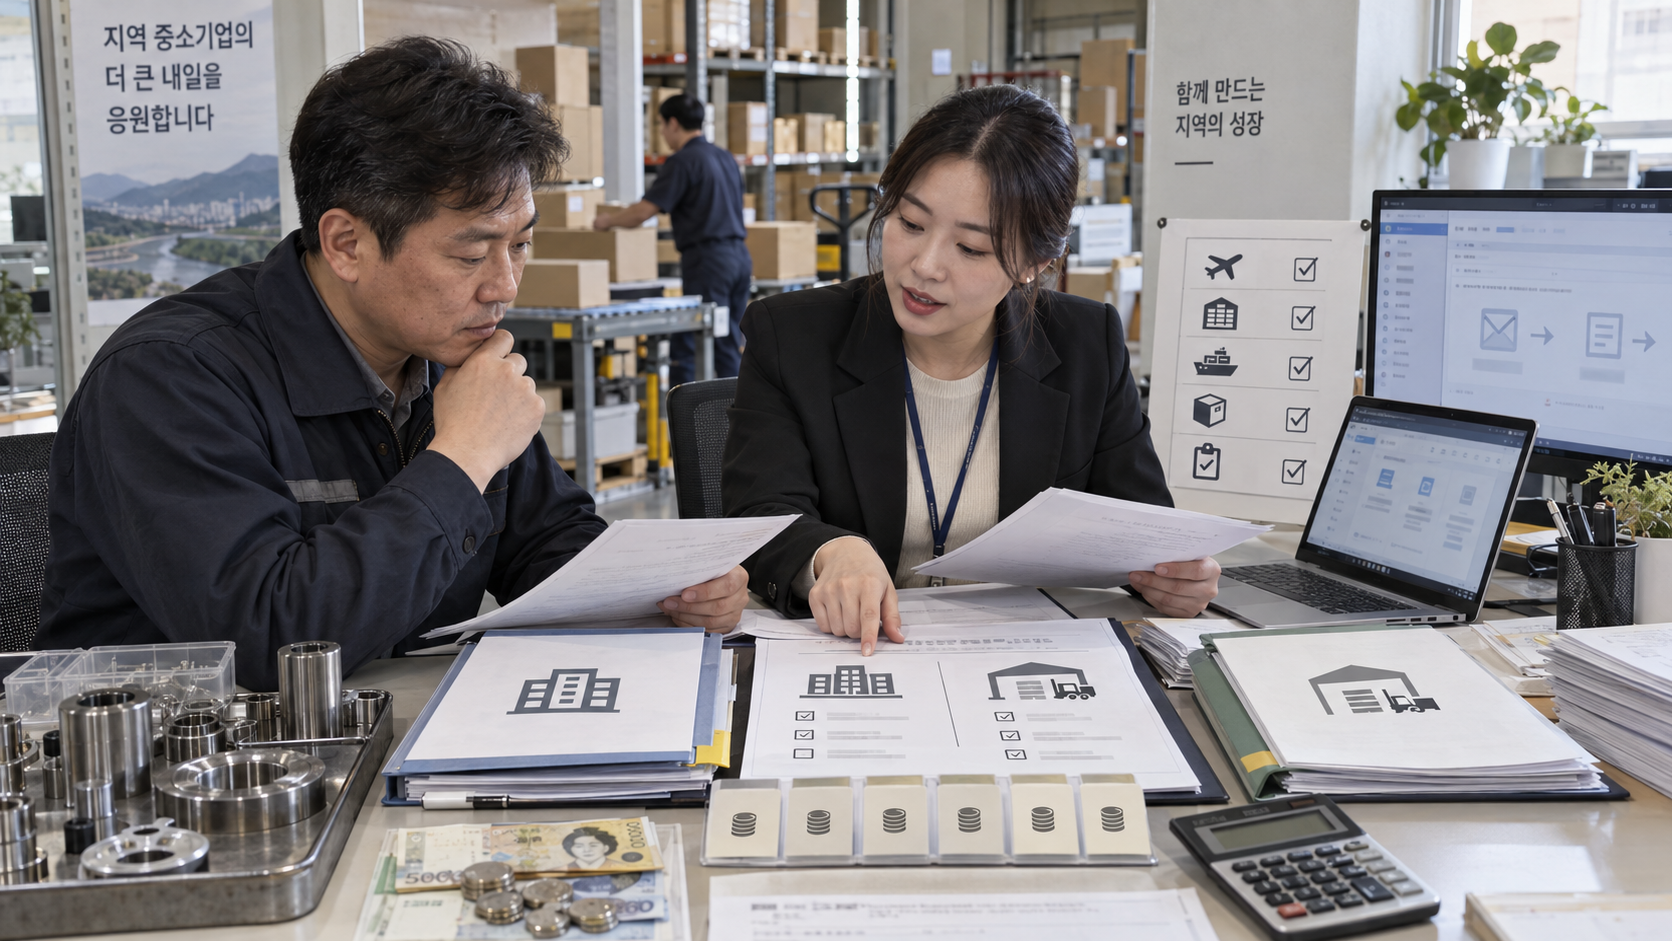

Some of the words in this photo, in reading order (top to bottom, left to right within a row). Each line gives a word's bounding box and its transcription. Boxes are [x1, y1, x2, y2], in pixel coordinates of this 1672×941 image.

[104, 24, 146, 53] 지역
[153, 21, 253, 51] 중소기업의
[105, 63, 126, 93] 더
[133, 64, 155, 92] 큰
[161, 62, 223, 91] 내일을
[1176, 79, 1209, 106] 함께
[1214, 77, 1265, 103] 만드는
[106, 104, 214, 134] 응원합니다
[1175, 112, 1223, 138] 지역의
[1229, 110, 1265, 137] 성장
